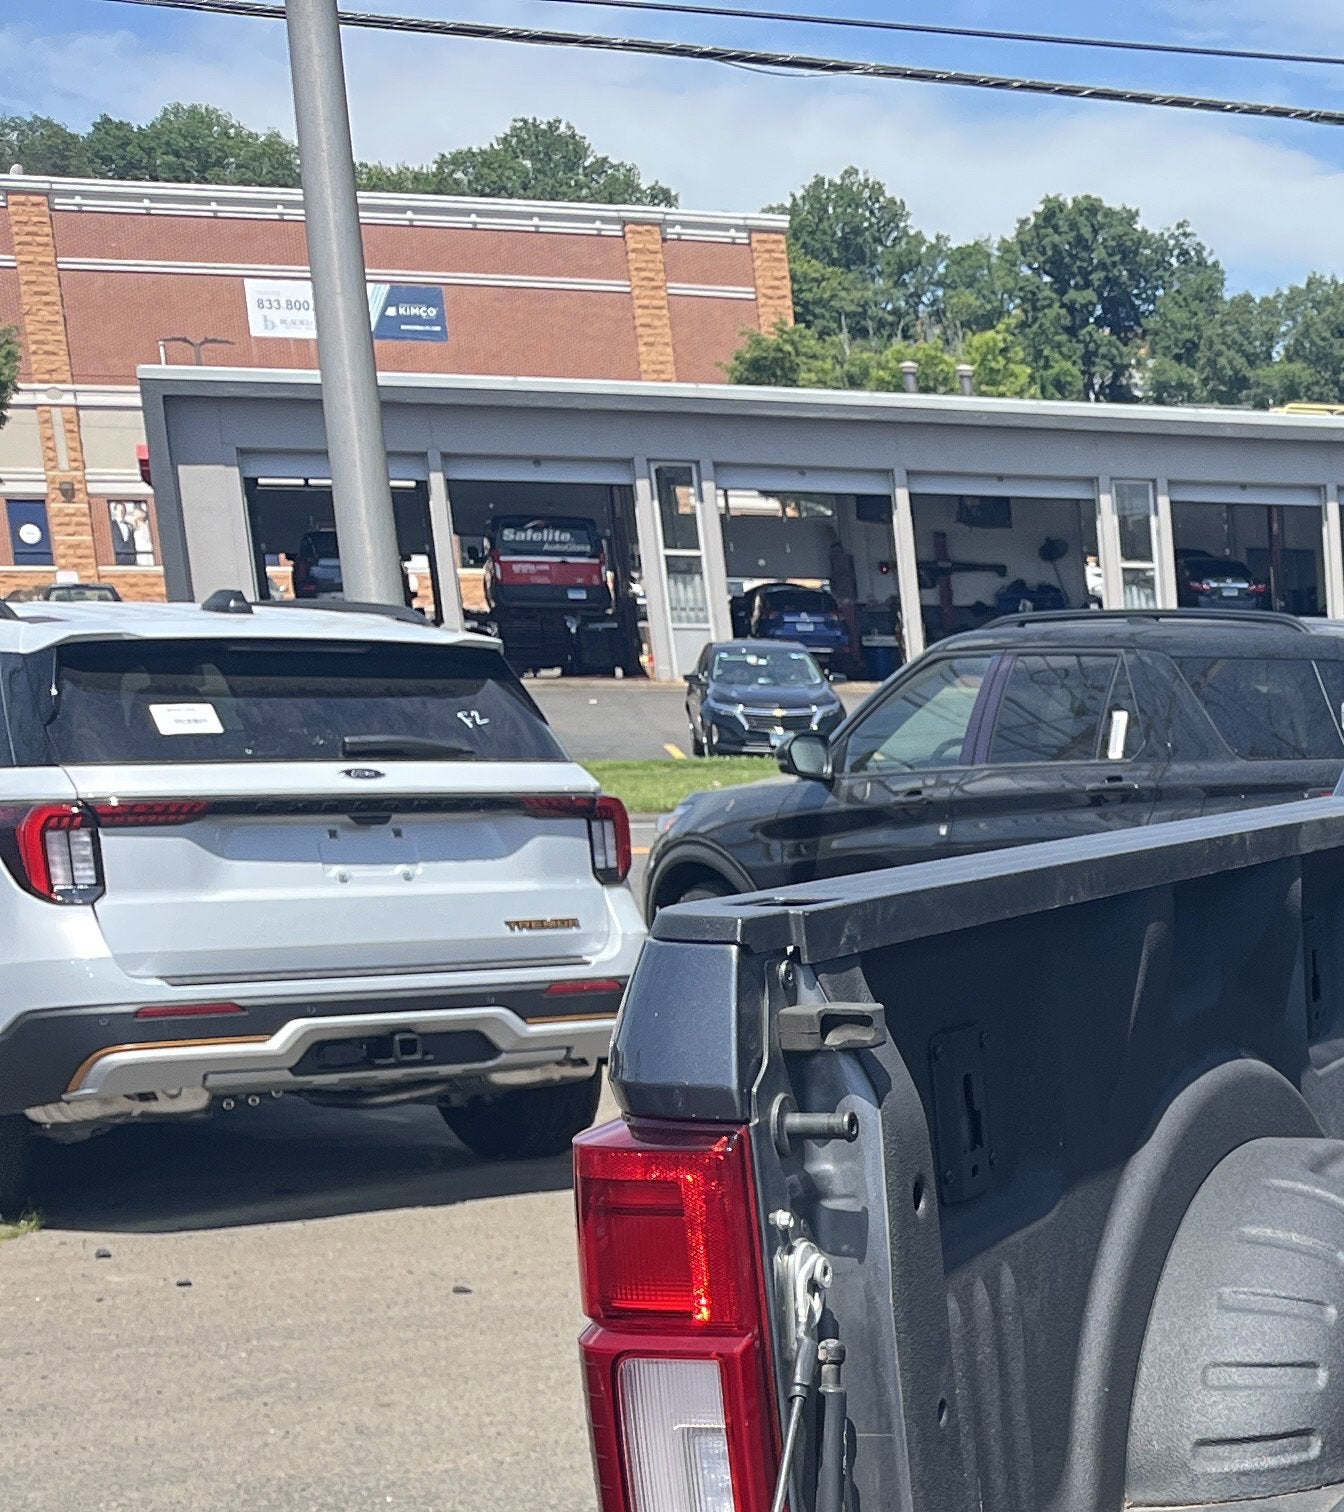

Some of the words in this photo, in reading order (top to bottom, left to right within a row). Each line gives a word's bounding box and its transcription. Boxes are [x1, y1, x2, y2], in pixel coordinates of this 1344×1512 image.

[398, 305, 437, 317] KIMCO
[502, 527, 571, 542] Safelite
[504, 918, 581, 931] TREMOR
